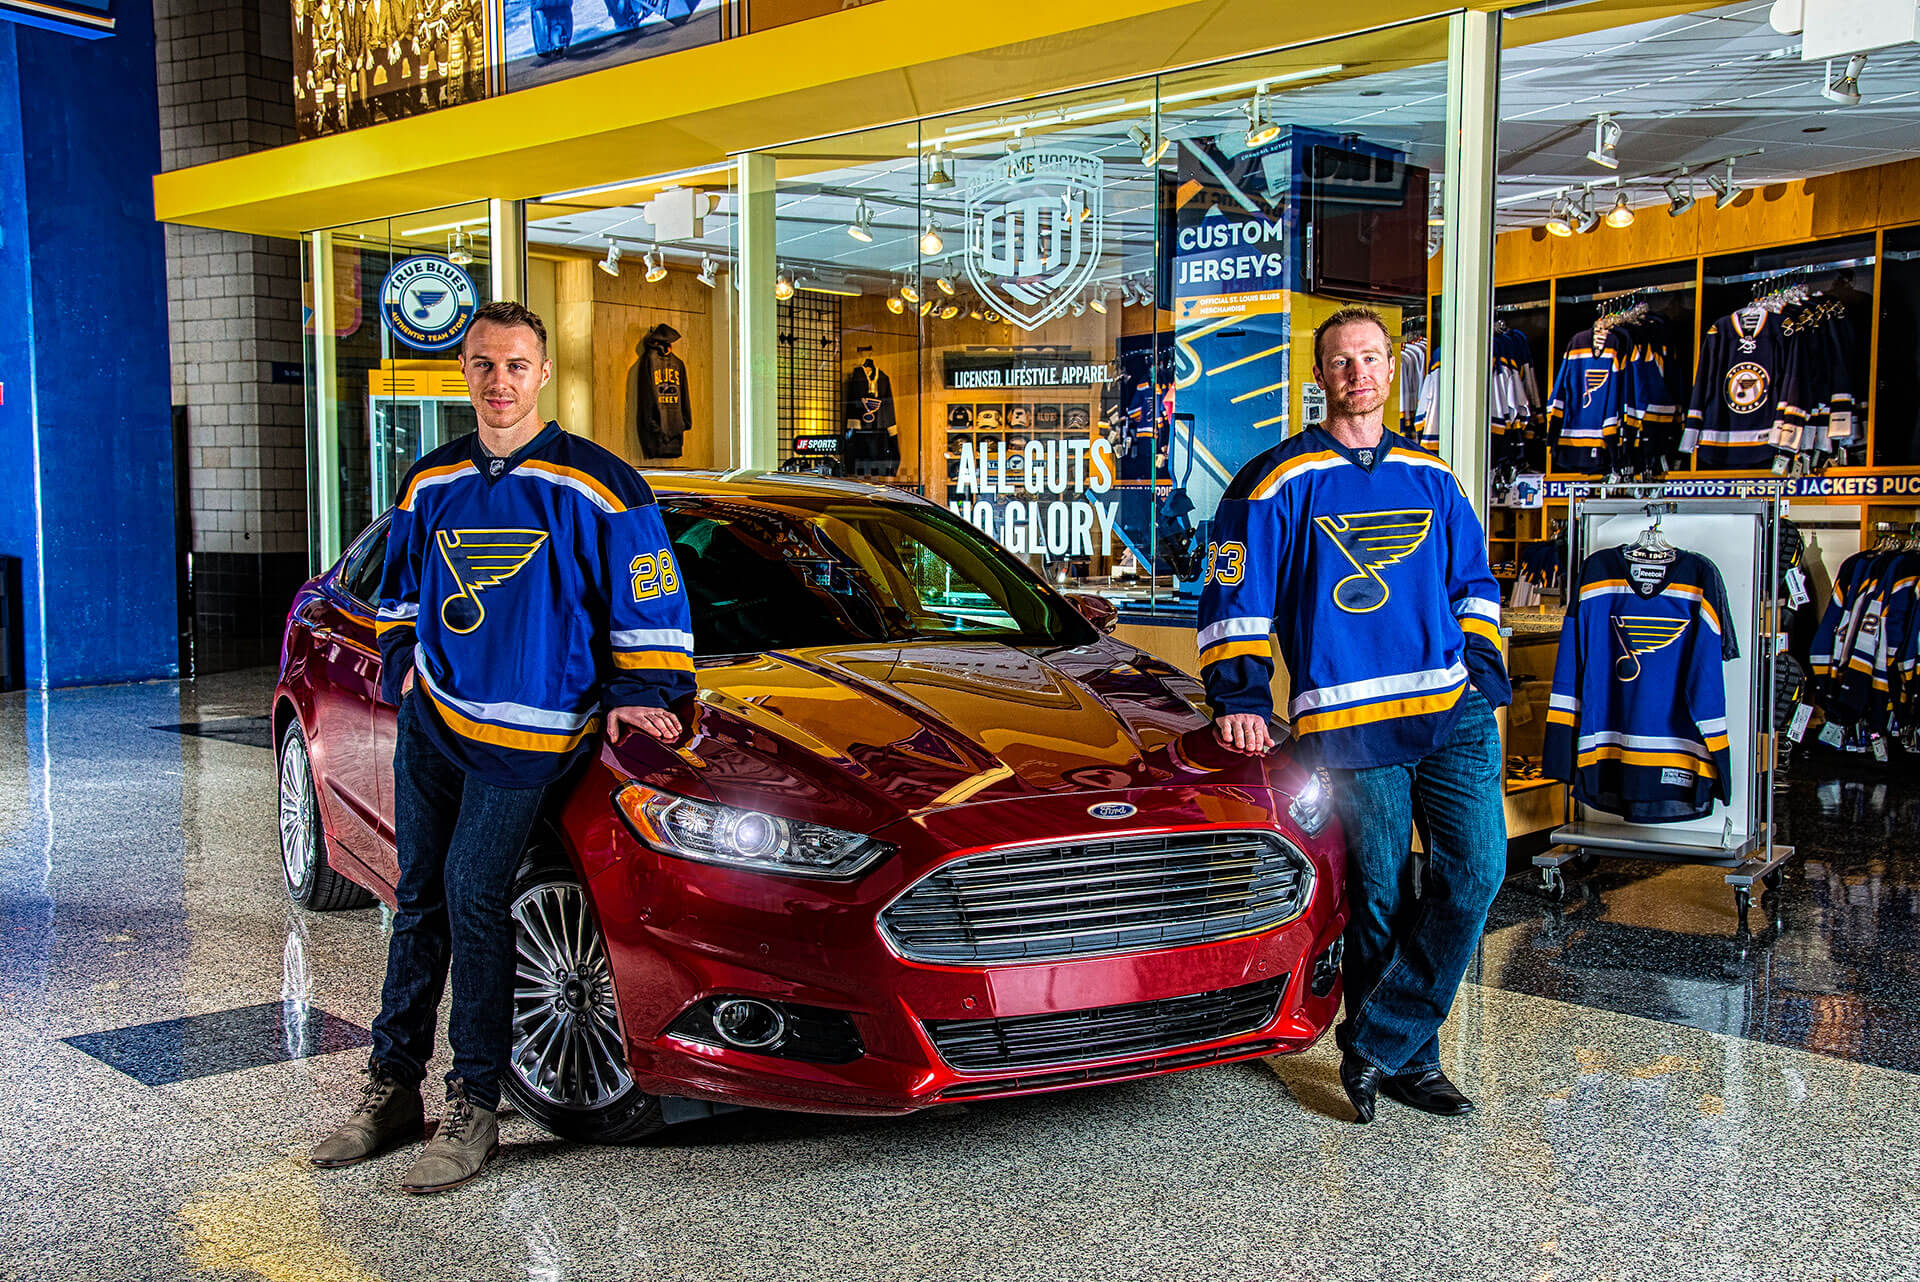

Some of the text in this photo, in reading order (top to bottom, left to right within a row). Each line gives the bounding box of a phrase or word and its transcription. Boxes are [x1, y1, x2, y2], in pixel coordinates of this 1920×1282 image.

[1039, 154, 1100, 179] HOCKEY
[1179, 218, 1283, 251] CUSTOM
[391, 262, 467, 292] TRUE BLUES
[1178, 253, 1282, 284] JERSEYS
[1200, 297, 1229, 305] OFFICIAL
[1239, 294, 1258, 303] LOUIS
[1259, 292, 1281, 301] BLUES
[1200, 304, 1246, 315] MERCHANDISE
[391, 311, 468, 342] AUTHENTIC TEAM STORE
[654, 367, 680, 386] BLUES
[954, 364, 1114, 389] LICENSED. LIFESTYLE. APPAREL.
[807, 440, 838, 449] SPORTS
[956, 439, 1113, 495] ALL GUTS
[1663, 480, 1726, 496] PHOTOS
[1800, 477, 1878, 496] JACKETS
[1004, 500, 1120, 556] GLORY
[629, 548, 679, 602] 28
[1099, 806, 1127, 817] Ford
